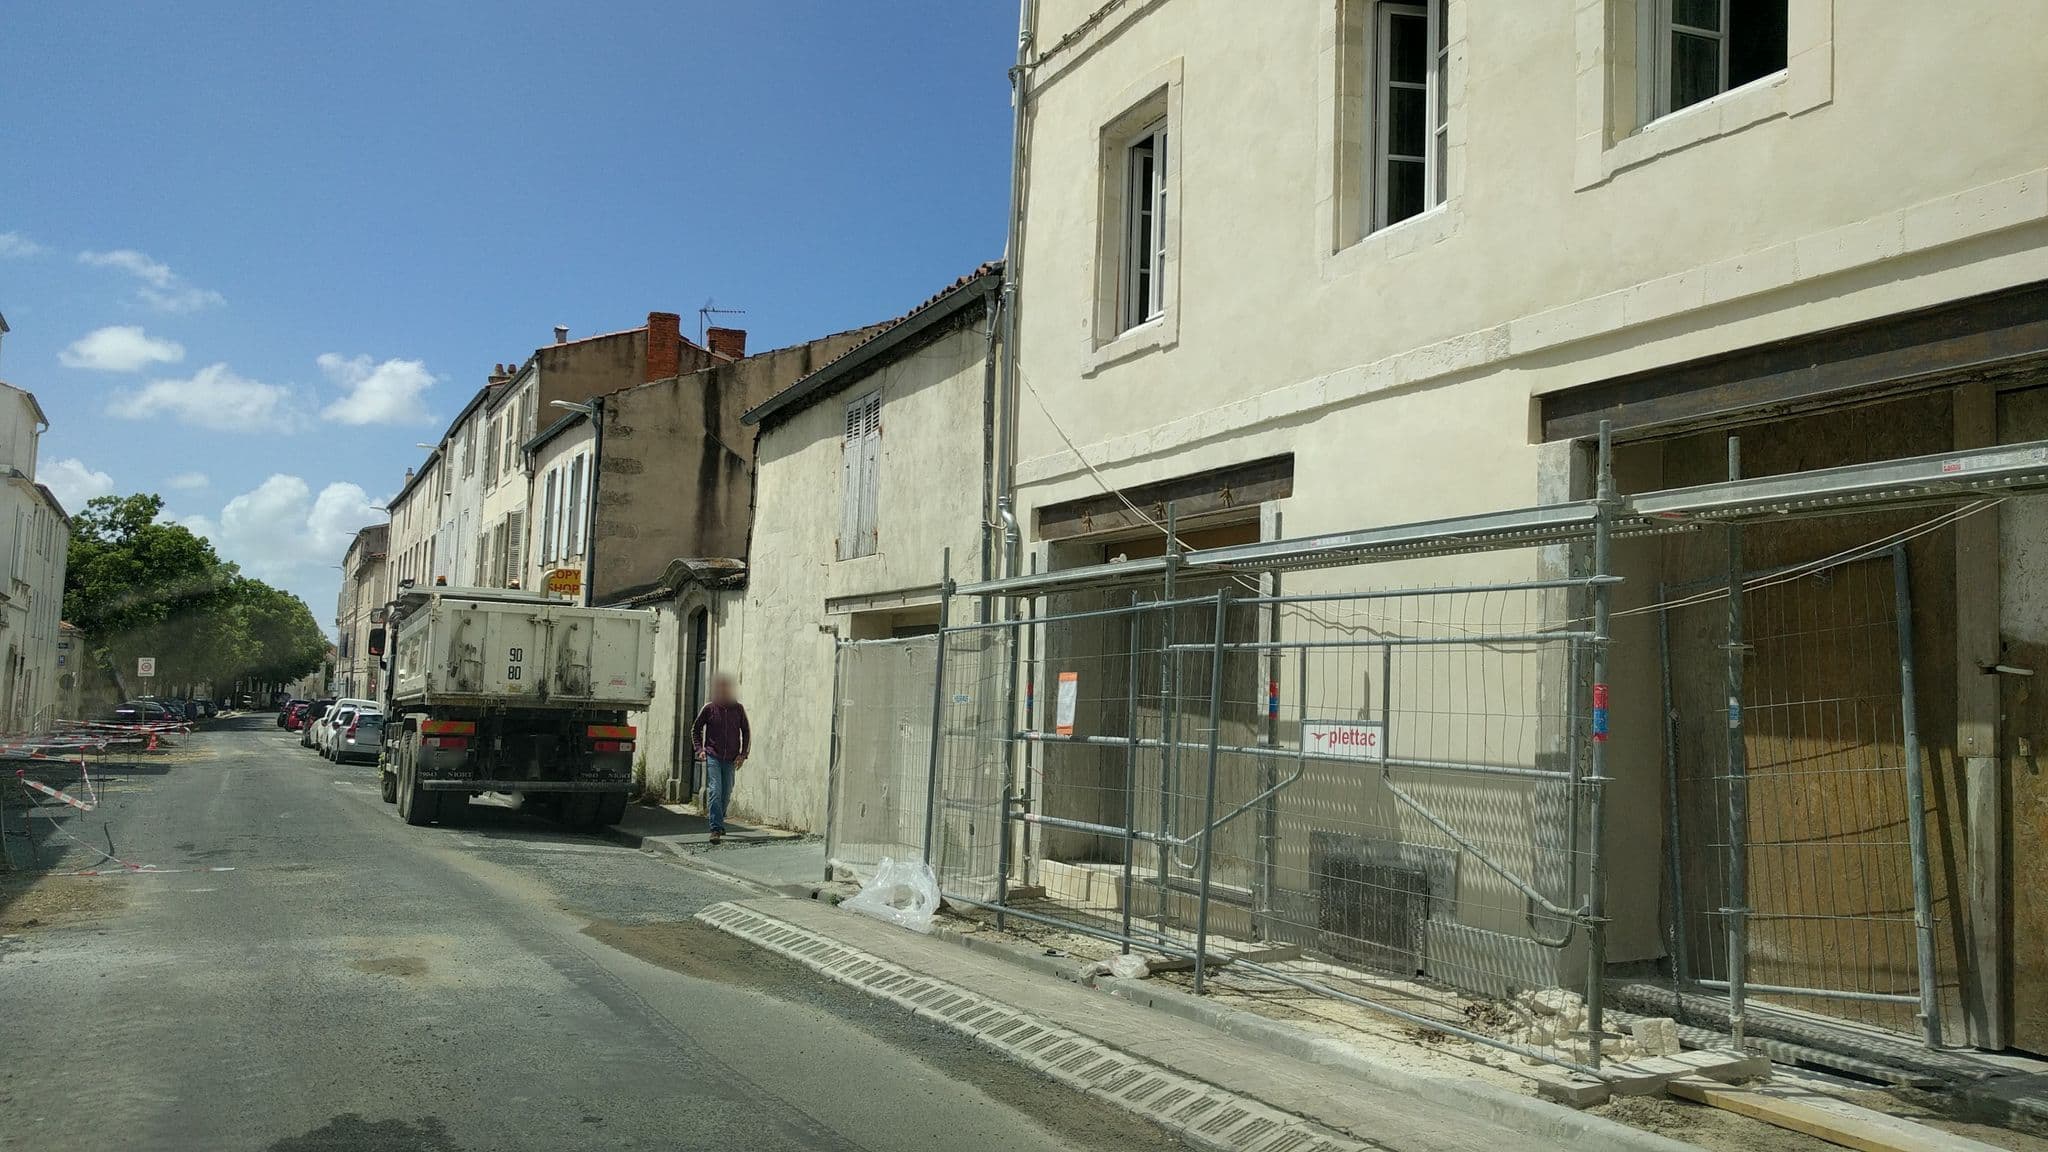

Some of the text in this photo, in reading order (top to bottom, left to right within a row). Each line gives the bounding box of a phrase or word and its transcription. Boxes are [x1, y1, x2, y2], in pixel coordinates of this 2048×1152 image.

[509, 647, 523, 662] 90
[508, 665, 522, 680] 80
[1328, 727, 1376, 748] plettac
